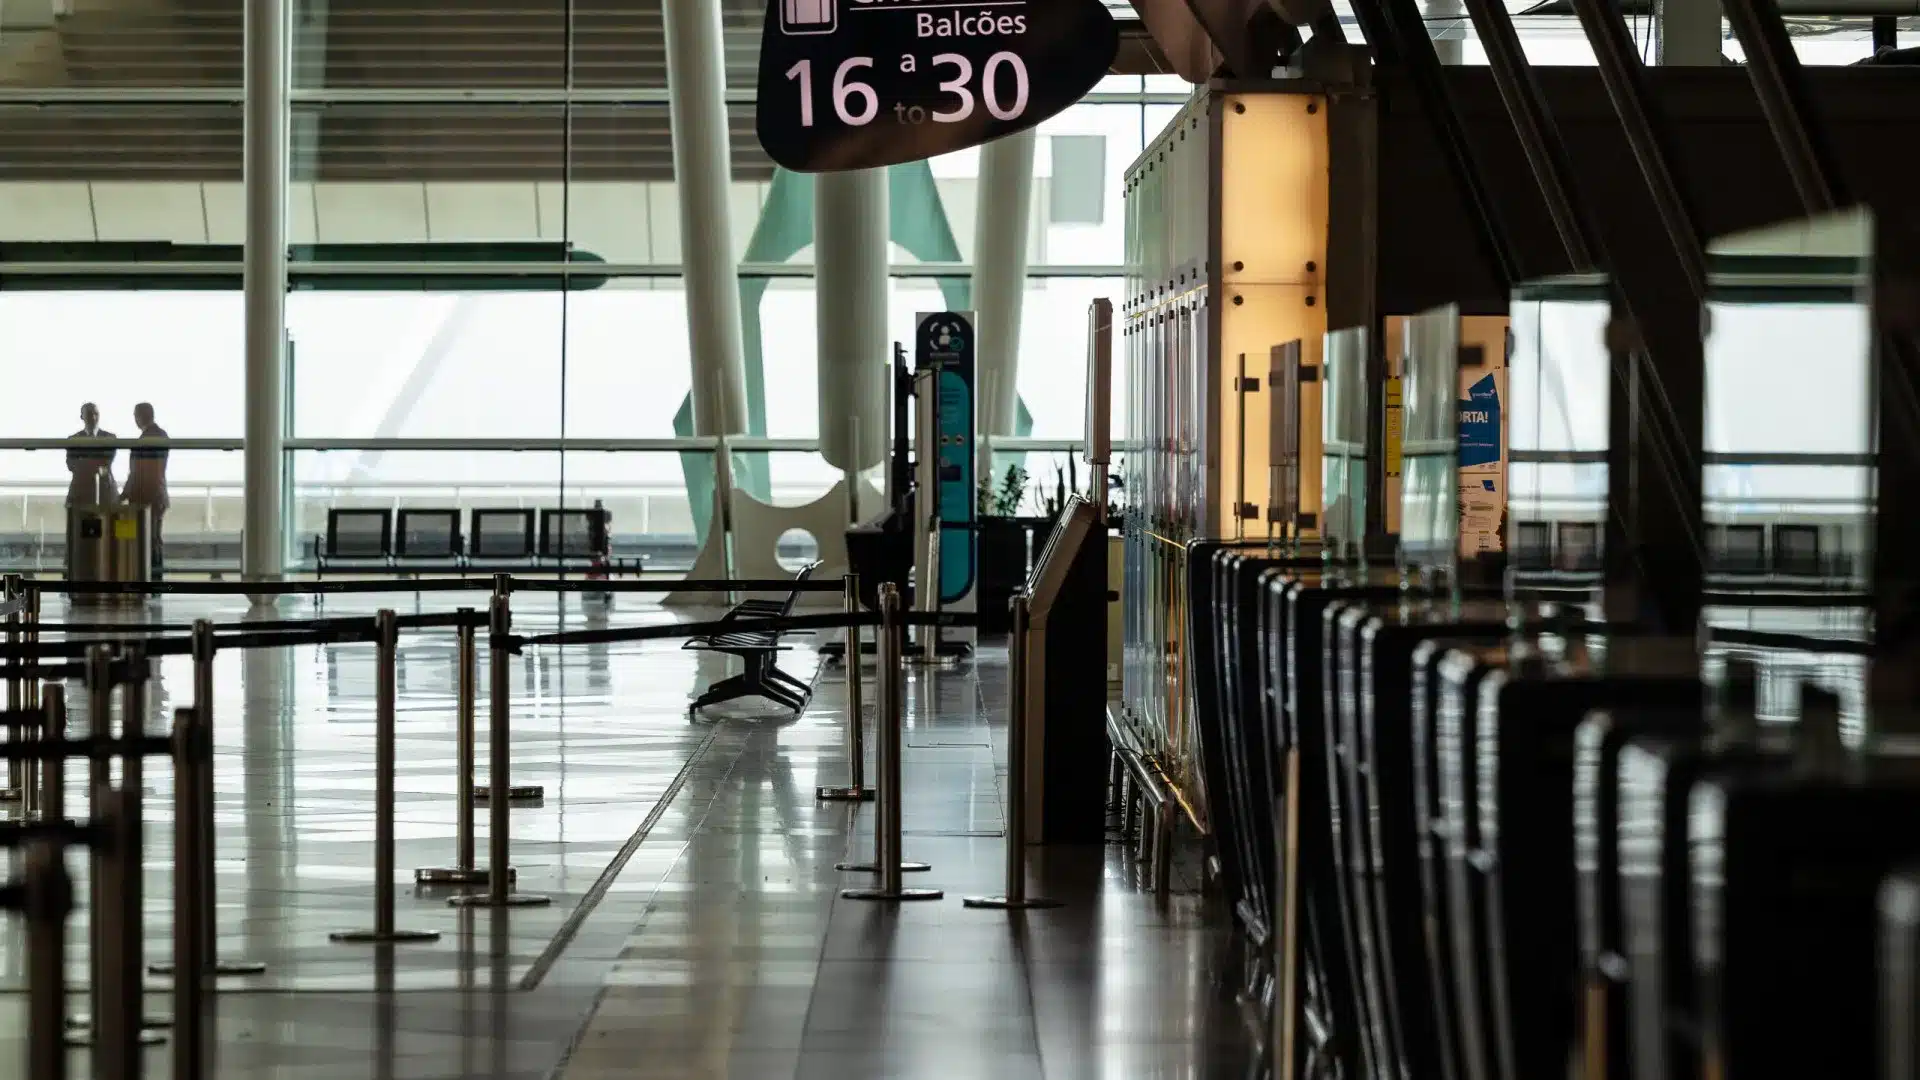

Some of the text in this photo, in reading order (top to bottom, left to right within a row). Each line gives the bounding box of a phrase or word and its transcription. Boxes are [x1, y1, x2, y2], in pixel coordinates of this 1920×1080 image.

[916, 11, 1027, 37] Balcões
[785, 51, 1029, 127] 16 a 30
[894, 102, 926, 125] to
